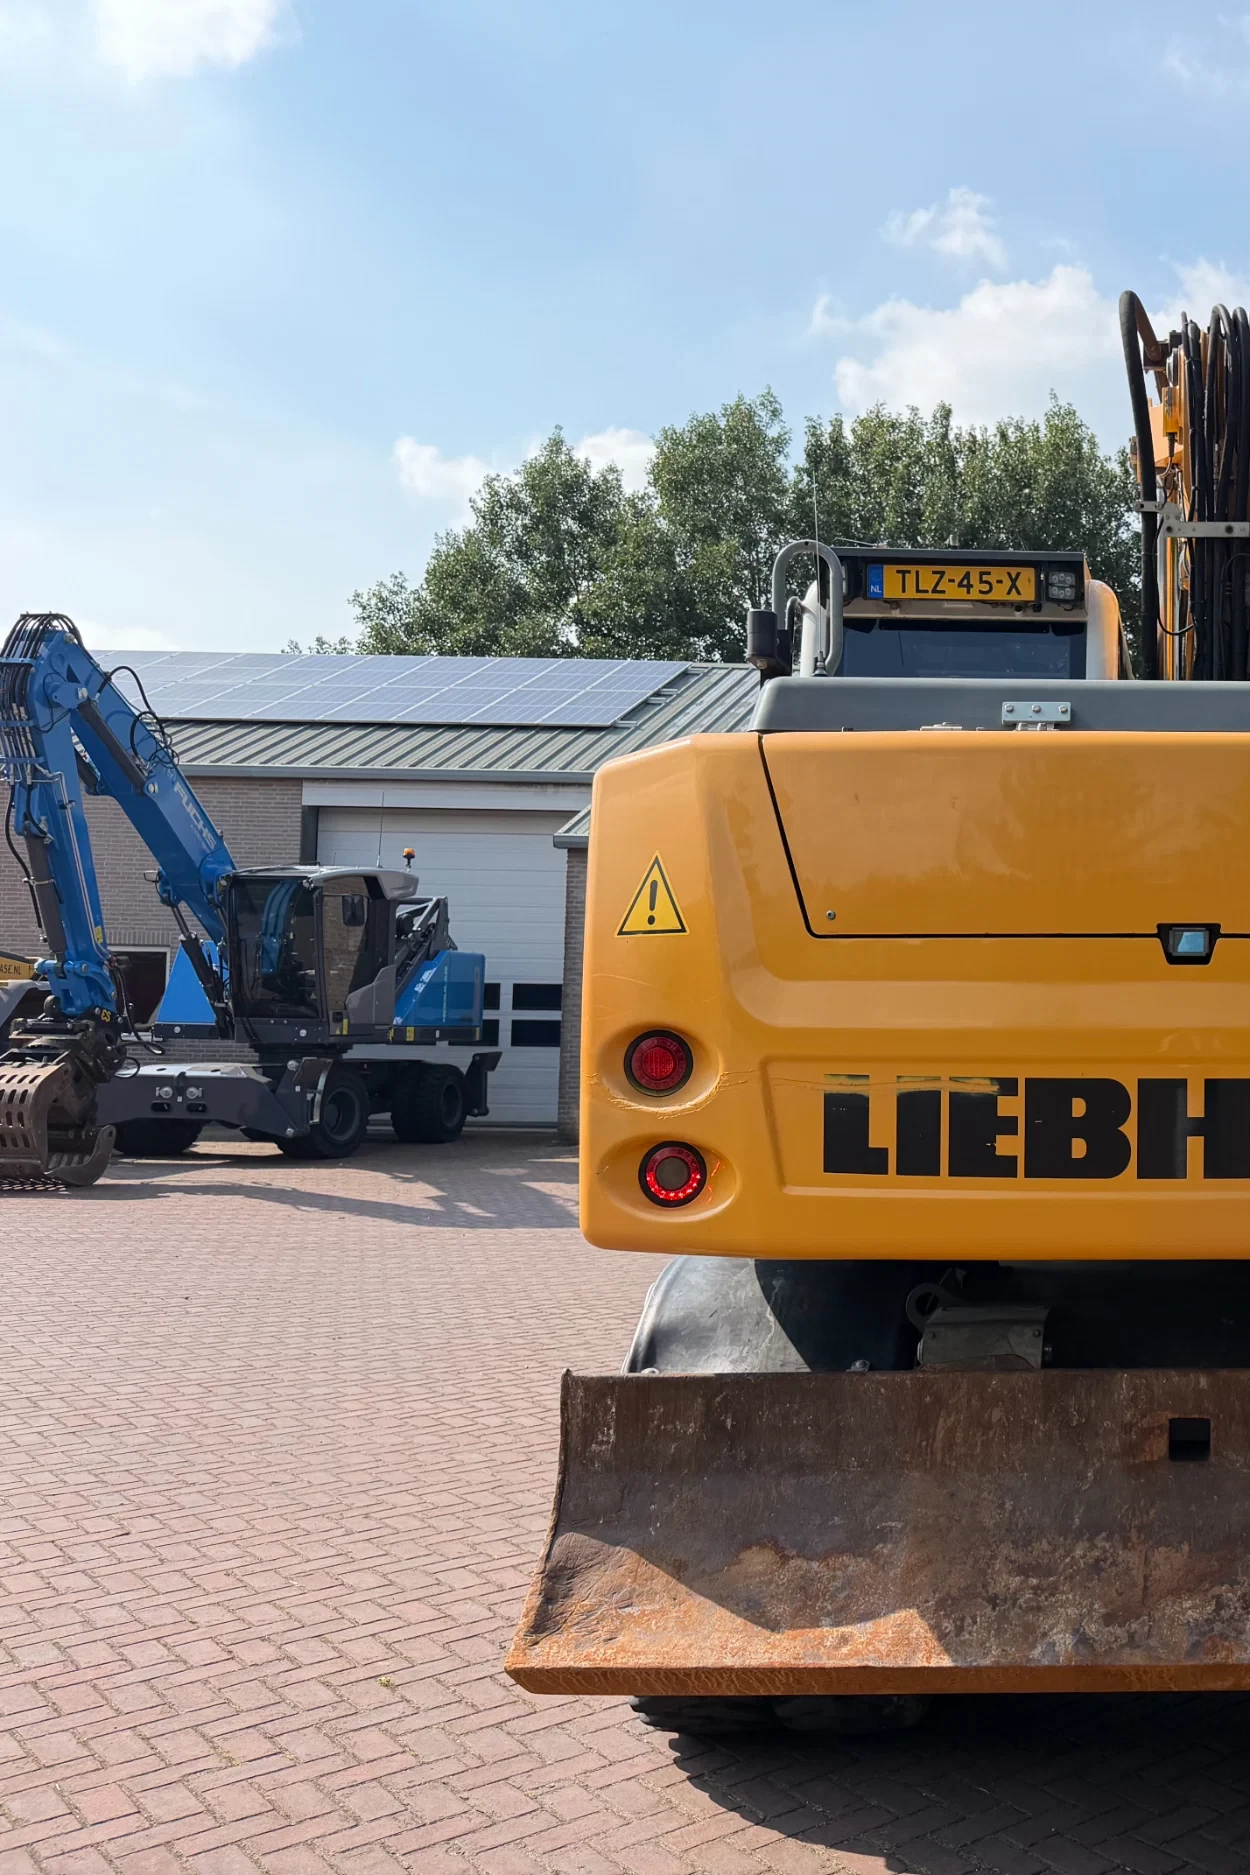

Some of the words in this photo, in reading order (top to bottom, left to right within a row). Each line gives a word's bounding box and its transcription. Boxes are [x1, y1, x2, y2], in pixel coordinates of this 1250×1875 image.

[870, 585, 882, 593] NL
[896, 569, 1022, 596] TLZ-45-X
[173, 780, 217, 851] FUCHS
